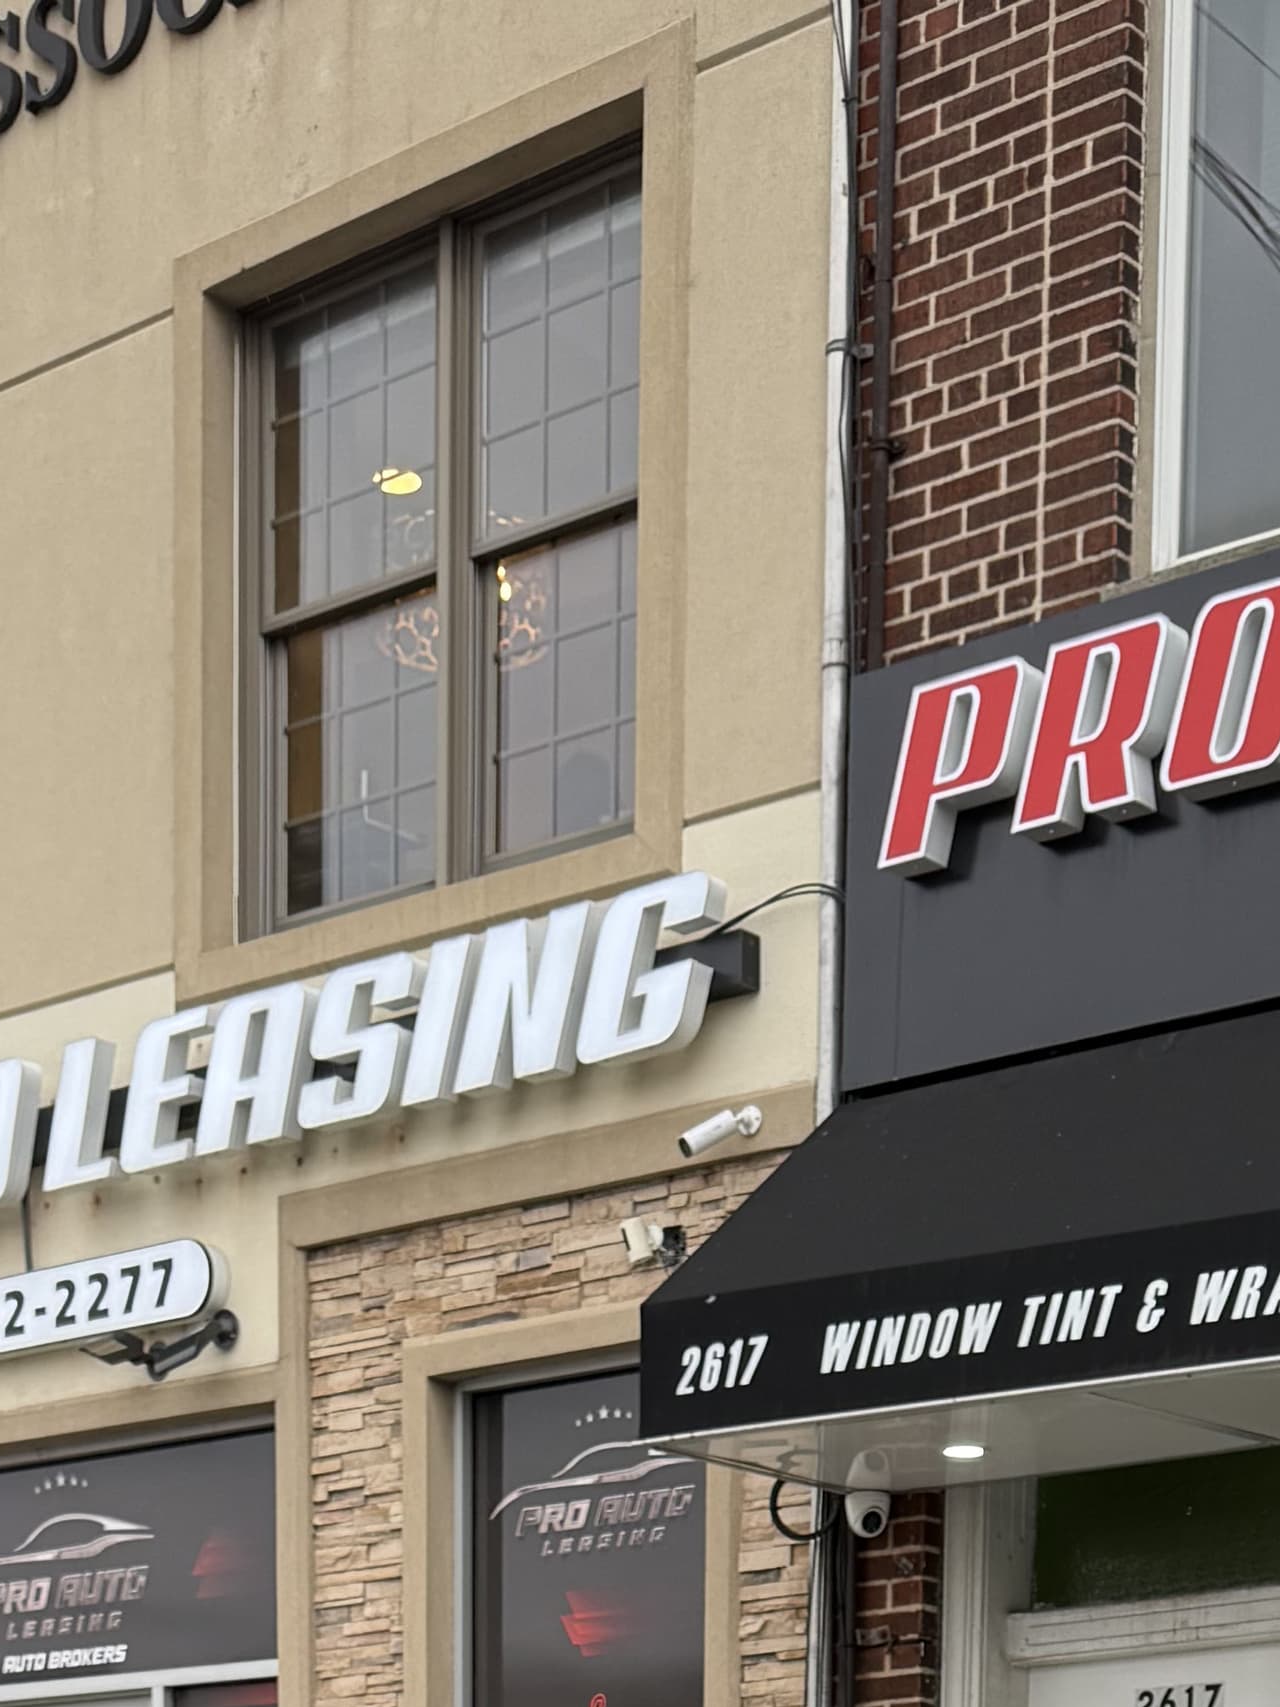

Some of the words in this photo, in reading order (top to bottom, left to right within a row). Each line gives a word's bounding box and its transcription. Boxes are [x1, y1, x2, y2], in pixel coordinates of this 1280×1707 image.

[43, 870, 727, 1192] LEASING
[675, 1335, 769, 1396] 2617
[820, 1301, 1001, 1375] WINDOW
[1016, 1284, 1121, 1348] TINT
[1137, 1279, 1168, 1333] &
[515, 1499, 591, 1537] PRO
[593, 1485, 695, 1527] AUTO
[540, 1525, 666, 1557] LEASING
[54, 1565, 150, 1611] AUTO
[6, 1612, 123, 1641] LEASING
[2, 1650, 46, 1674] AUTO
[48, 1644, 128, 1670] BROKERS
